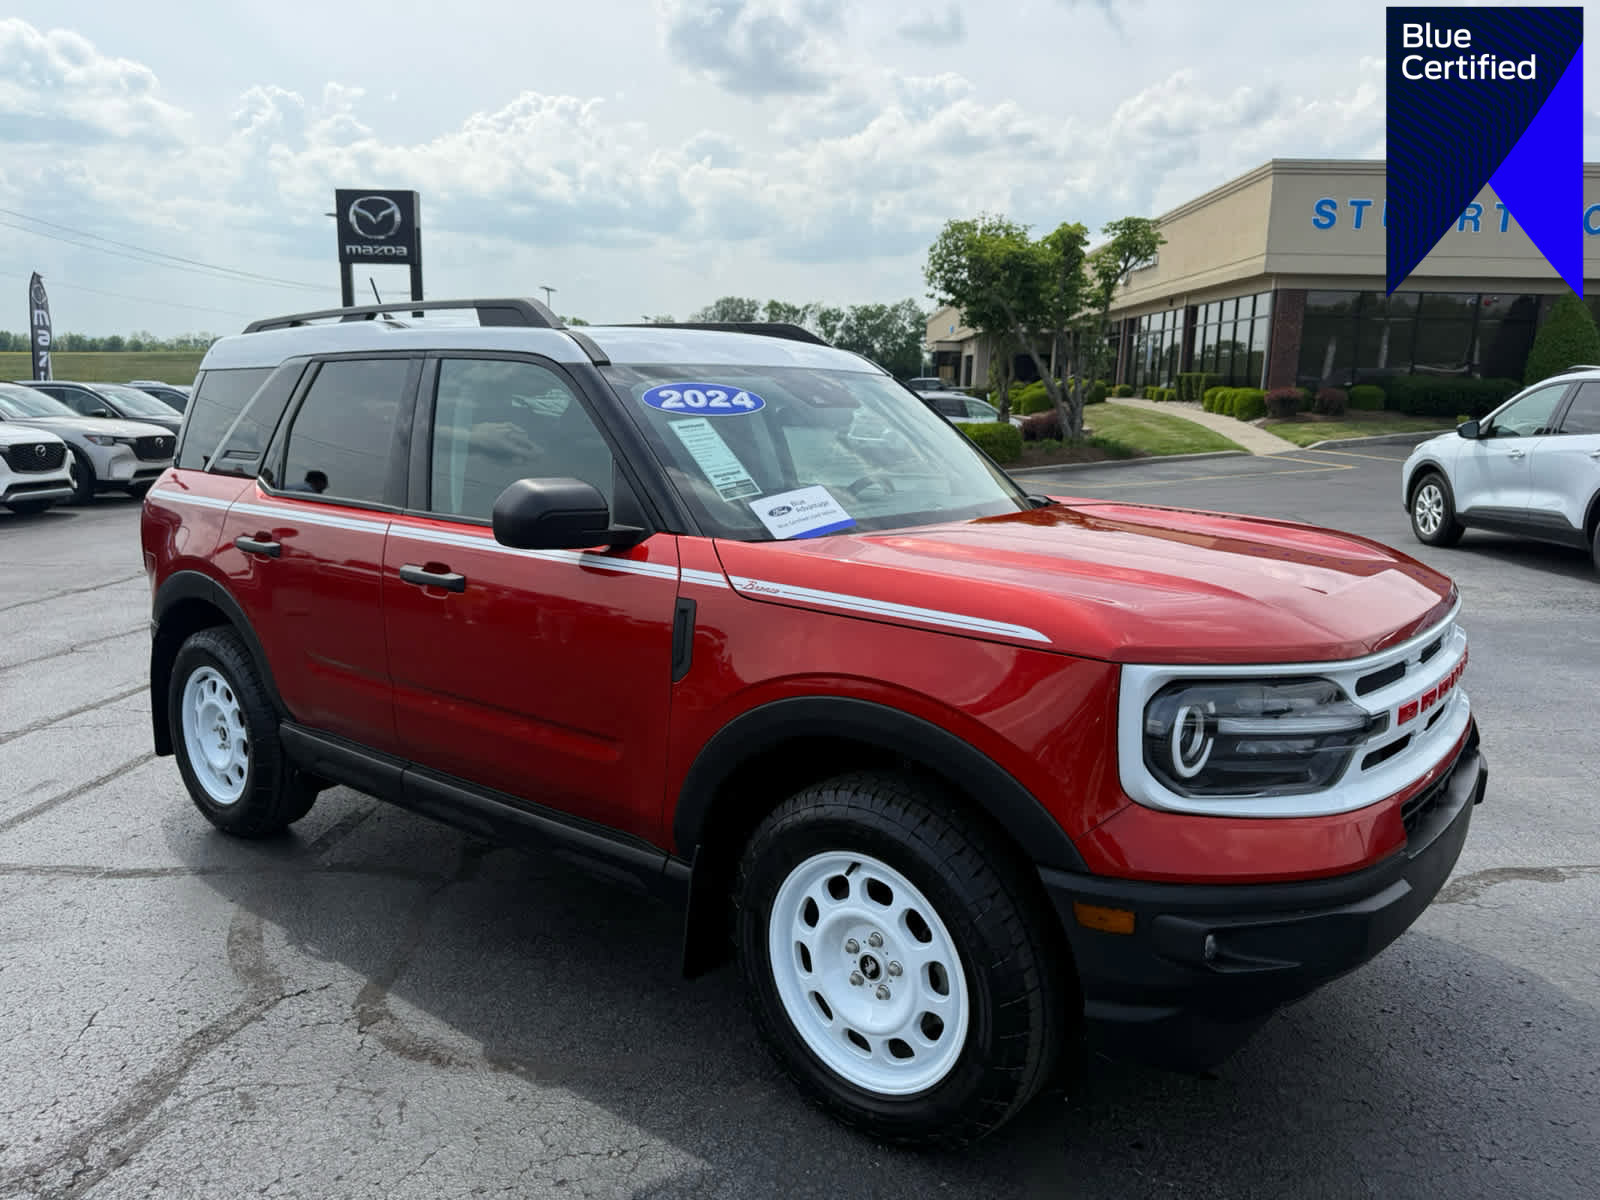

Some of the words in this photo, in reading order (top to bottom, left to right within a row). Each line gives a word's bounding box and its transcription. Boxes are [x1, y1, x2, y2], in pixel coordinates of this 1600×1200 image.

[1311, 197, 1512, 233] STRT
[345, 244, 408, 256] mazda
[657, 389, 756, 409] 2024
